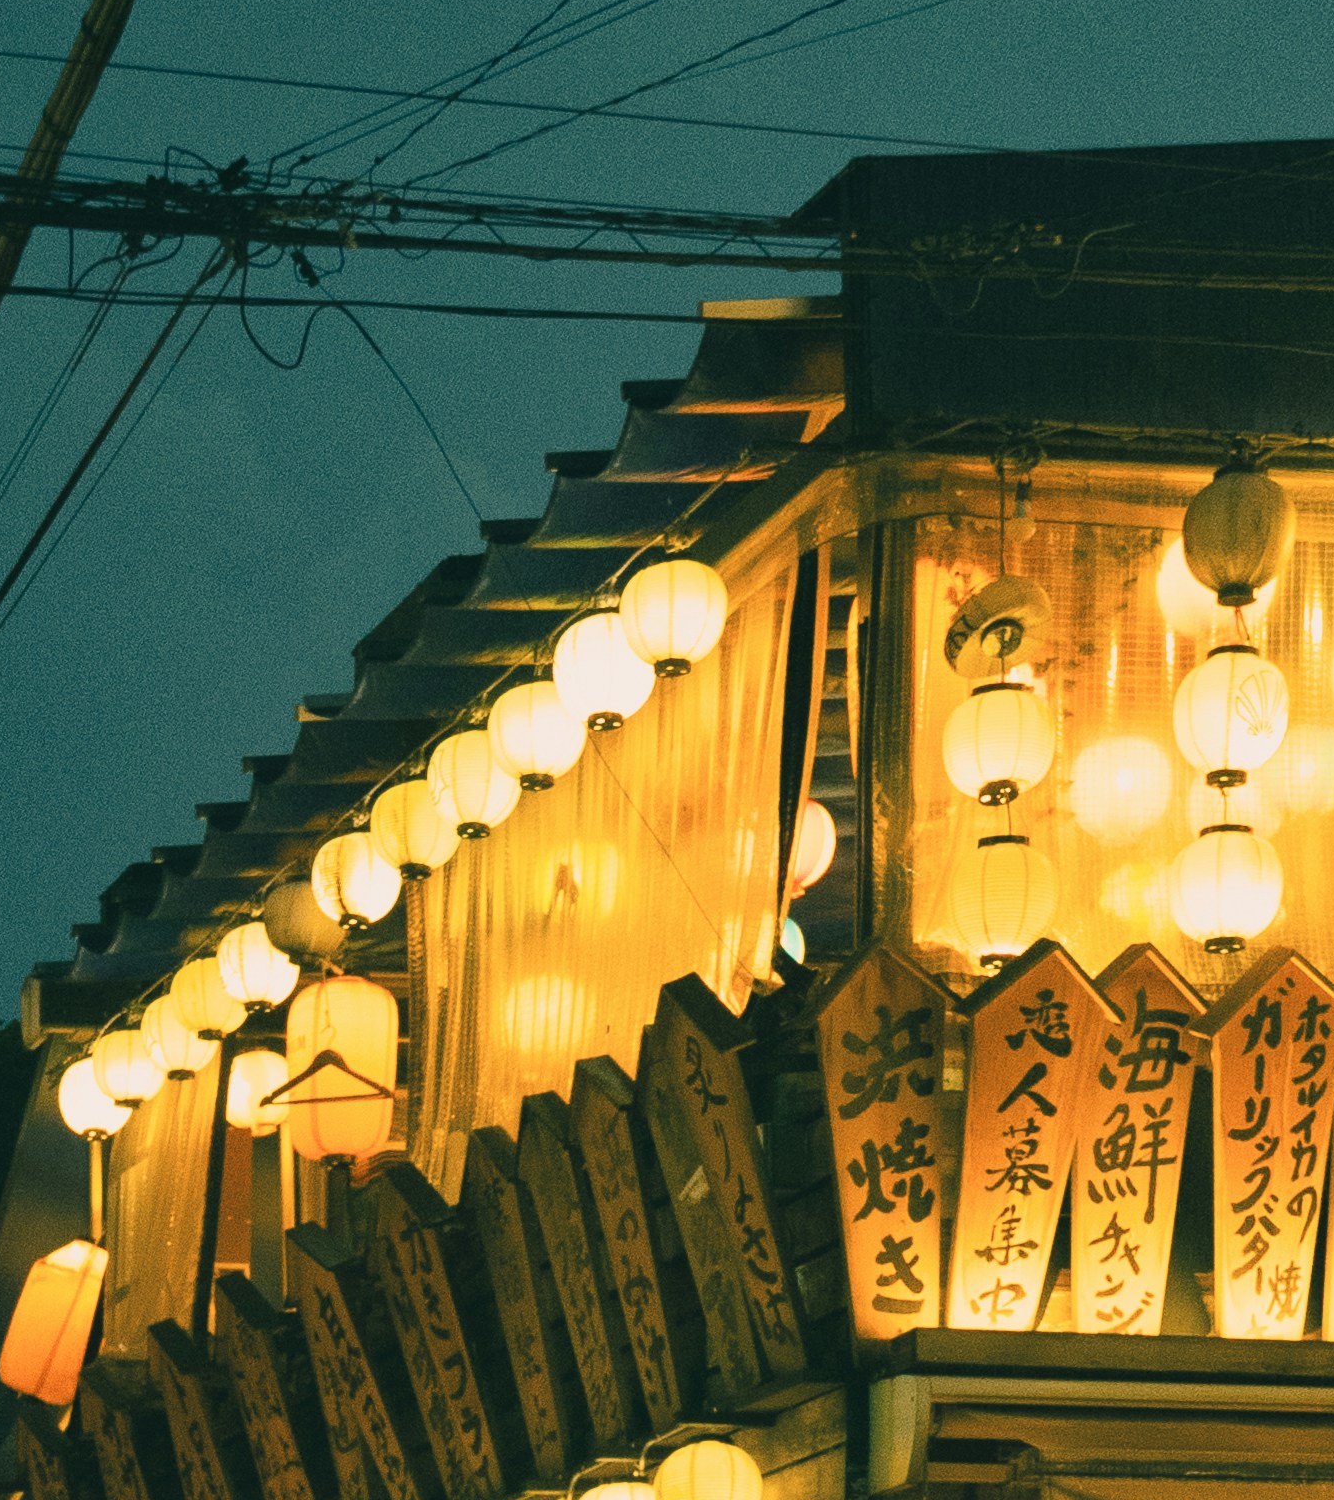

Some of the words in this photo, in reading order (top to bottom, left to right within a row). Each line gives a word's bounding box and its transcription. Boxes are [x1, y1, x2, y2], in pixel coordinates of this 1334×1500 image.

[837, 1003, 936, 1315] 浜焼き
[970, 987, 1073, 1325] 恋人募集中
[1287, 995, 1332, 1242] ホタルイカの
